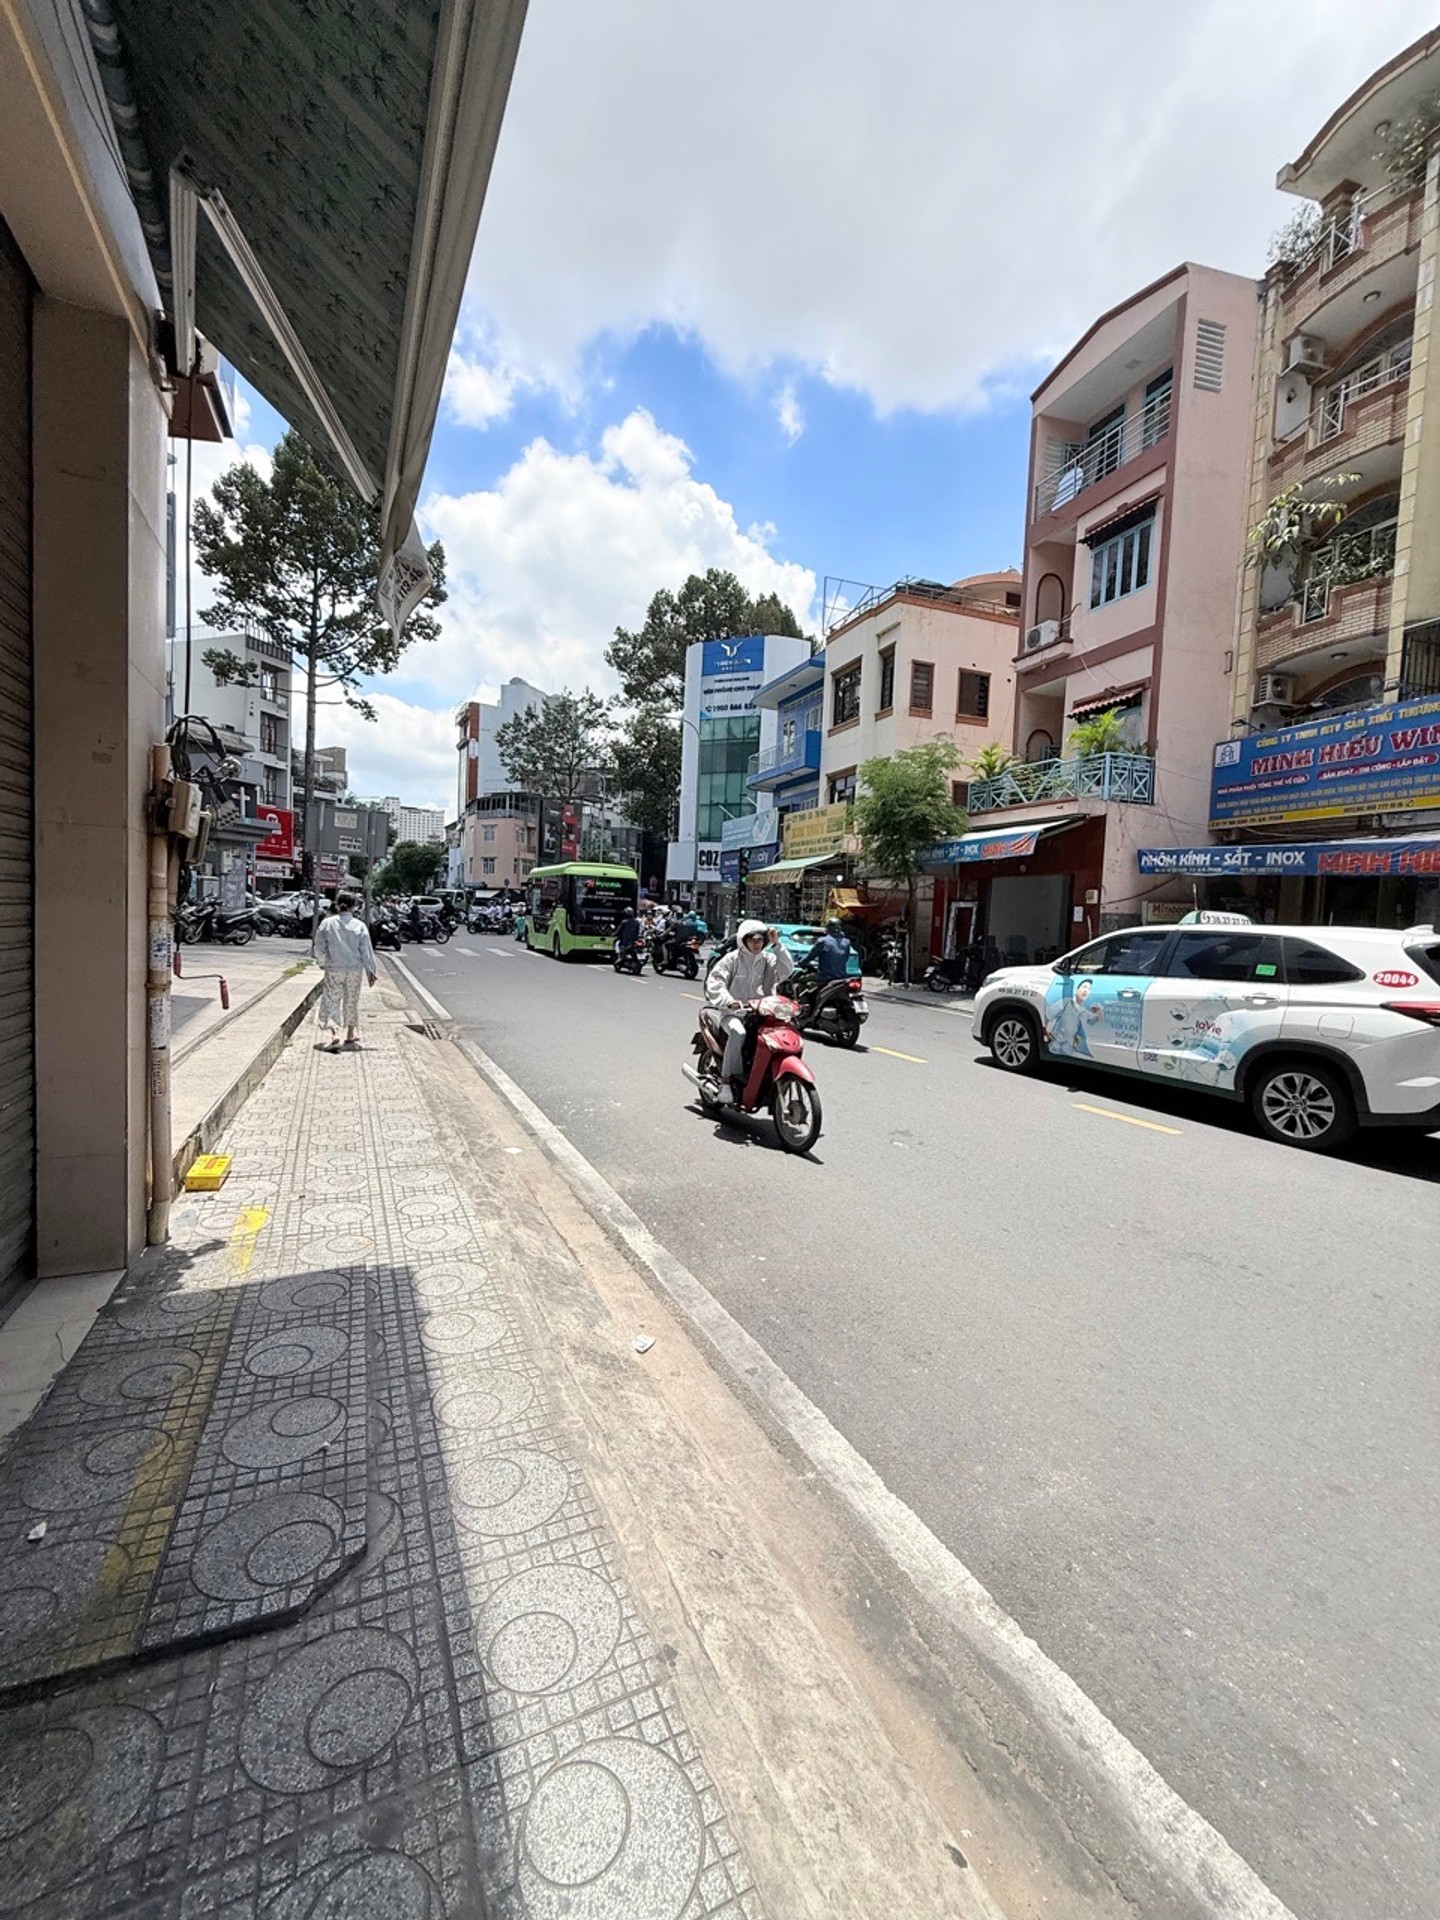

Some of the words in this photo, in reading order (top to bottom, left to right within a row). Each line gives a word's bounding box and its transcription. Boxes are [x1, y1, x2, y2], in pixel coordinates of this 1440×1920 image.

[1281, 733, 1291, 743] TY
[1250, 747, 1314, 776] MINH
[1371, 762, 1392, 772] CÔNG
[1141, 851, 1176, 867] NHÔM
[1179, 850, 1211, 866] KÍNH
[1222, 847, 1252, 866] SẮT
[1266, 851, 1305, 866] INOX
[1375, 973, 1416, 985] 20044
